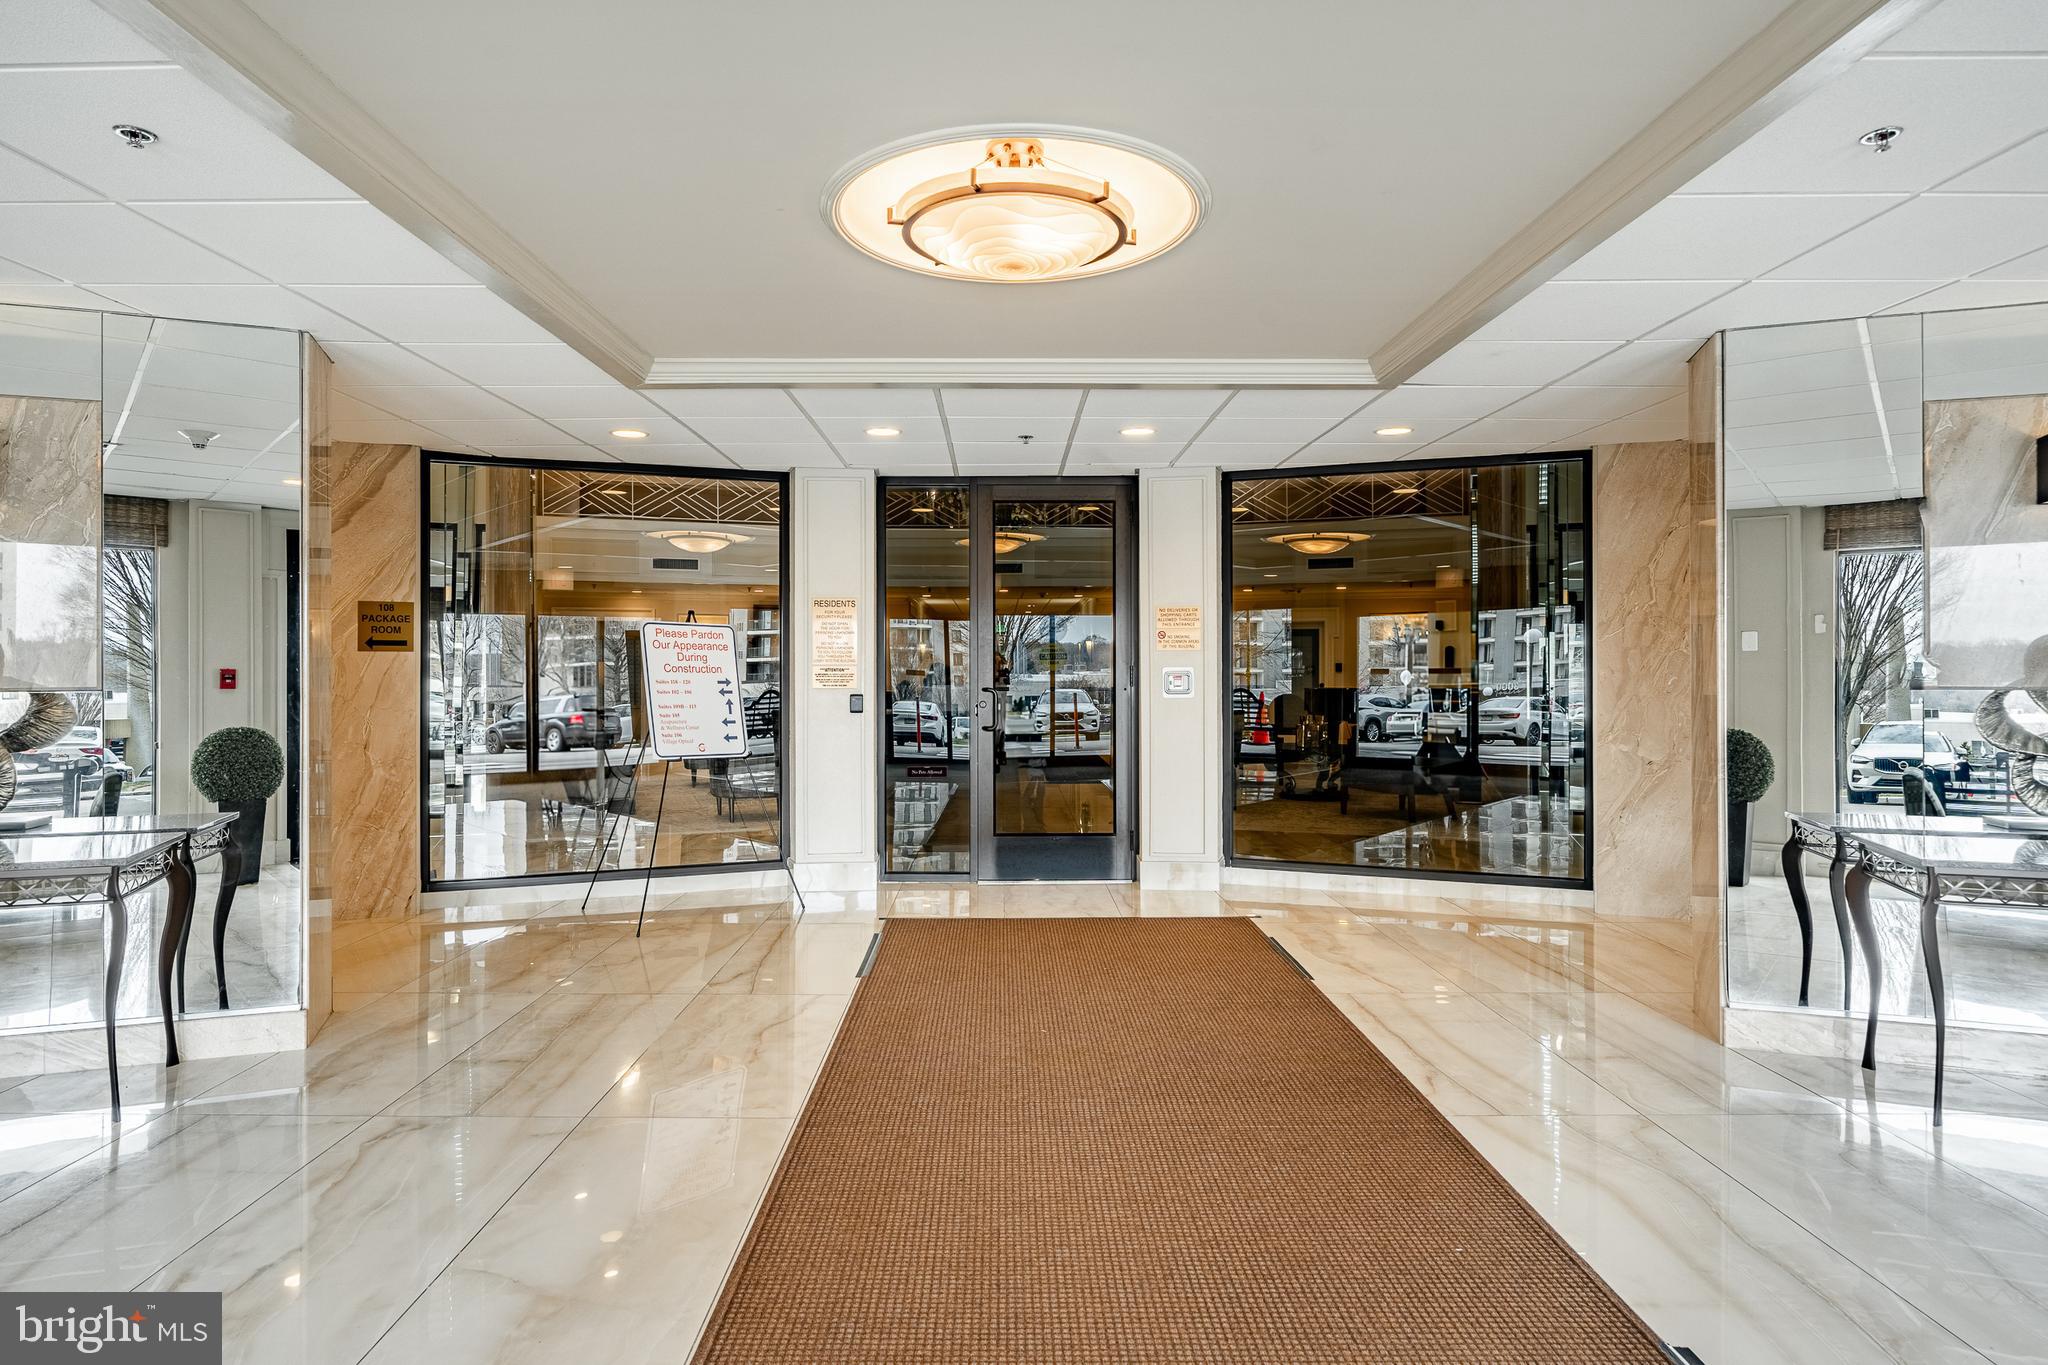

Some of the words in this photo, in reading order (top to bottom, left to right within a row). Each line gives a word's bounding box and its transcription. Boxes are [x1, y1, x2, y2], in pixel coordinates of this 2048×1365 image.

[379, 603, 395, 612] 108
[813, 599, 856, 608] RESIDENTS
[361, 614, 411, 623] PACKAGE
[370, 625, 402, 634] ROOM
[655, 628, 688, 638] Please
[690, 629, 724, 640] Pardon
[652, 640, 671, 649] Our
[673, 640, 729, 652] Appearance
[676, 652, 708, 664] During
[663, 663, 723, 674] Construction
